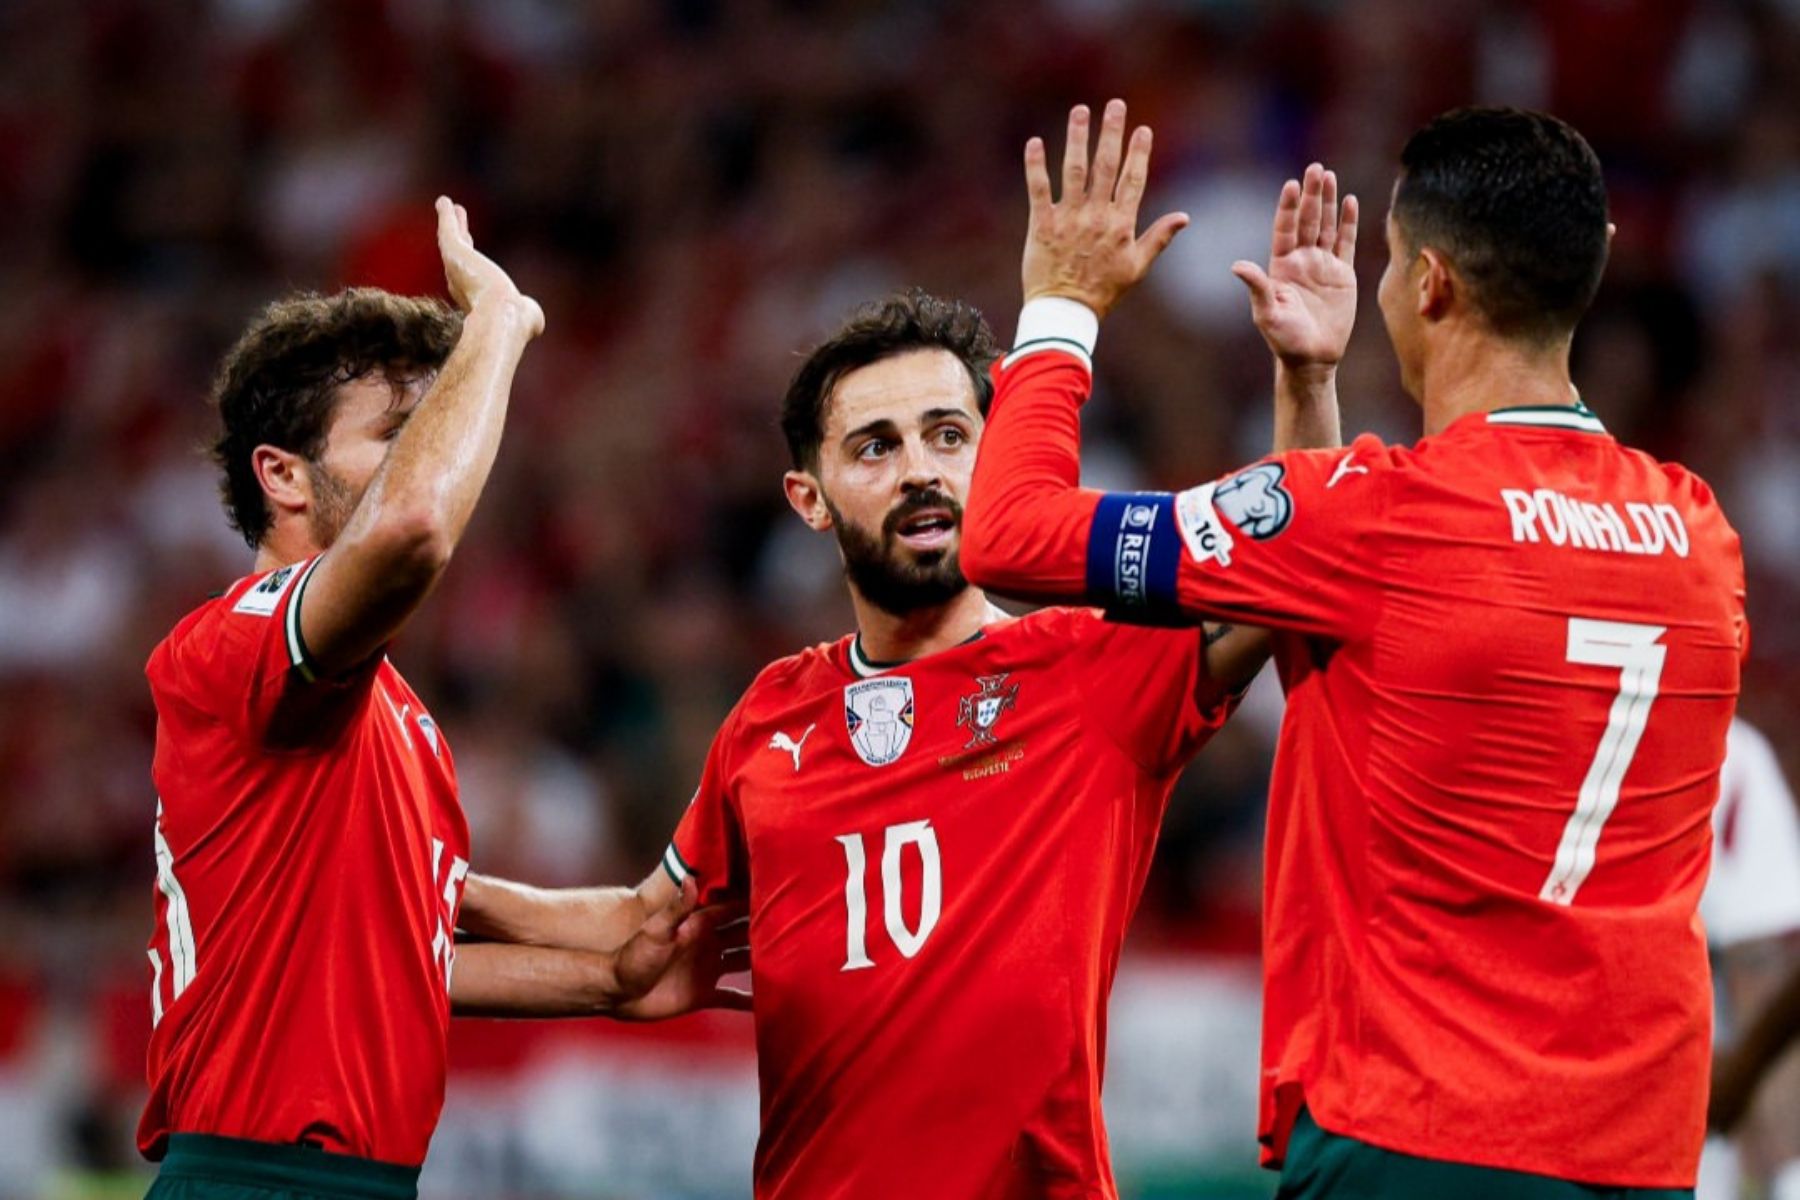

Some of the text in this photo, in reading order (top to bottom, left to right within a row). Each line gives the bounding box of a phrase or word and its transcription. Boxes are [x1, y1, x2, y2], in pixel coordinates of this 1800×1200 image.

[1501, 488, 1690, 558] RONALDO
[1538, 617, 1667, 906] 7
[834, 819, 942, 971] 10
